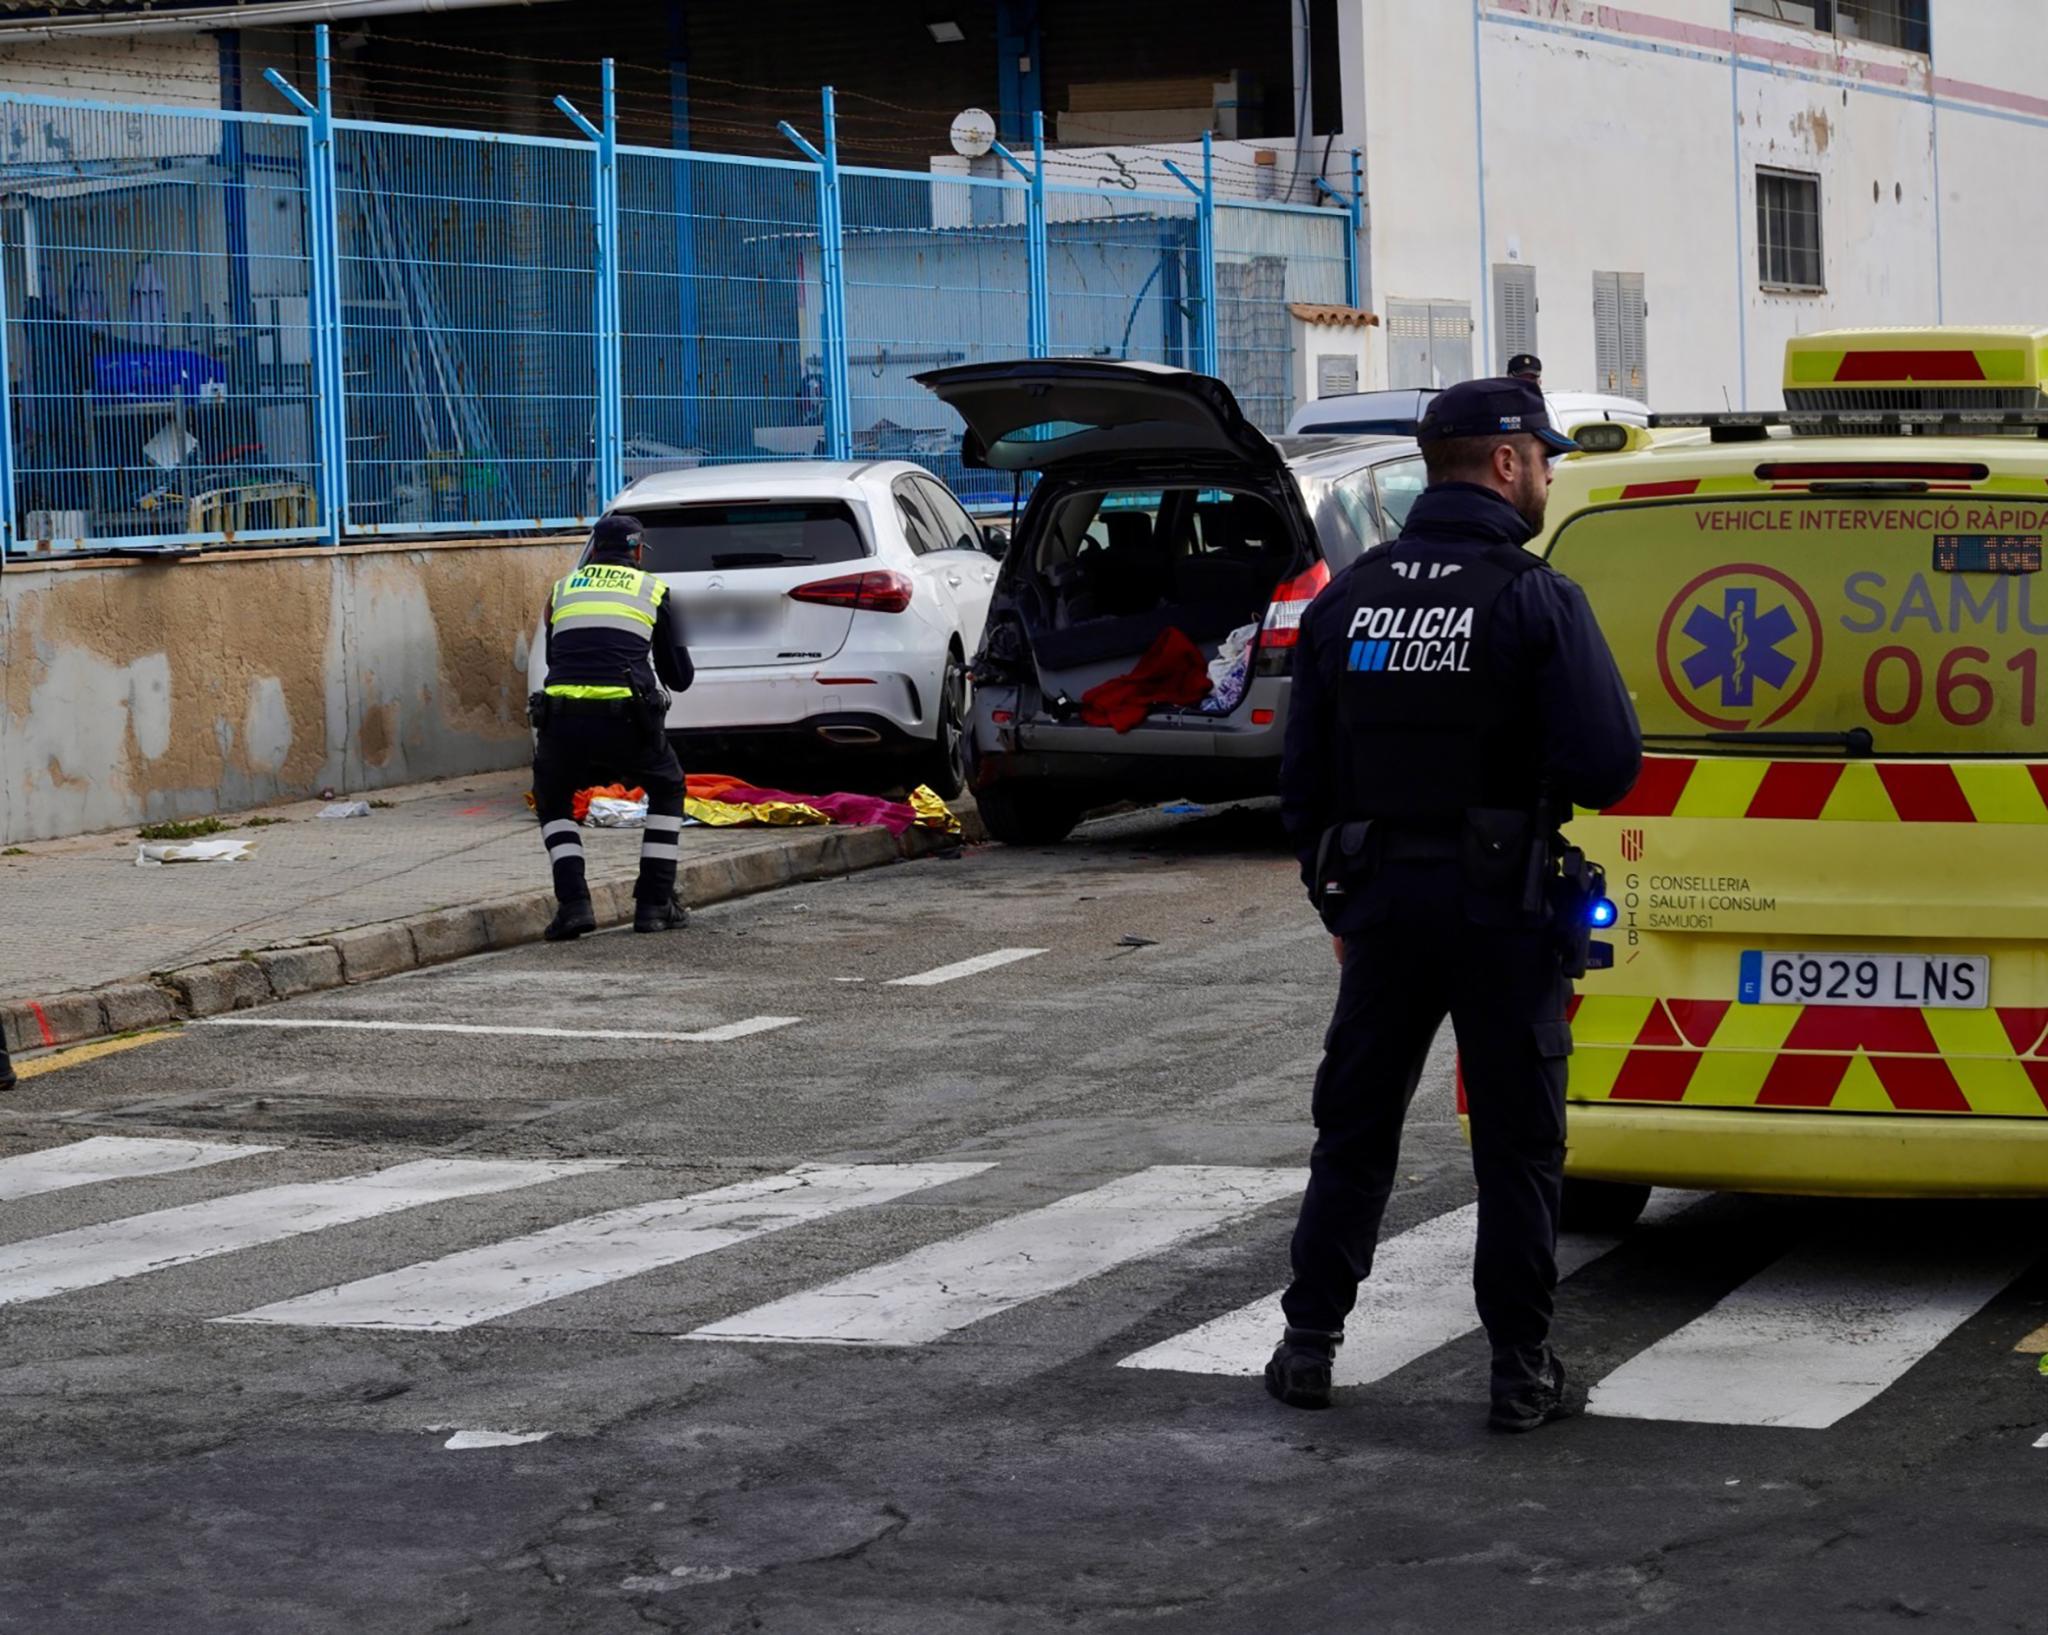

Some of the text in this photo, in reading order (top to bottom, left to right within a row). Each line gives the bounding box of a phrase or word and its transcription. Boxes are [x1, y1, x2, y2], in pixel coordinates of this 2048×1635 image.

[1696, 510, 1792, 530] VEHICLE
[1800, 505, 1959, 530] INTERVENCIÓ
[588, 580, 633, 590] LOCAL
[1347, 607, 1474, 639] POLICIA
[1387, 640, 1471, 672] LOCAL
[1863, 645, 2037, 727] 061
[1650, 875, 1751, 892] CONSELLERIA
[1649, 894, 1697, 910] SALUT
[1709, 896, 1776, 911] CONSUM
[1649, 914, 1713, 929] SAMU061
[1745, 982, 1754, 993] E
[1770, 960, 1976, 1000] 6929 LNS
